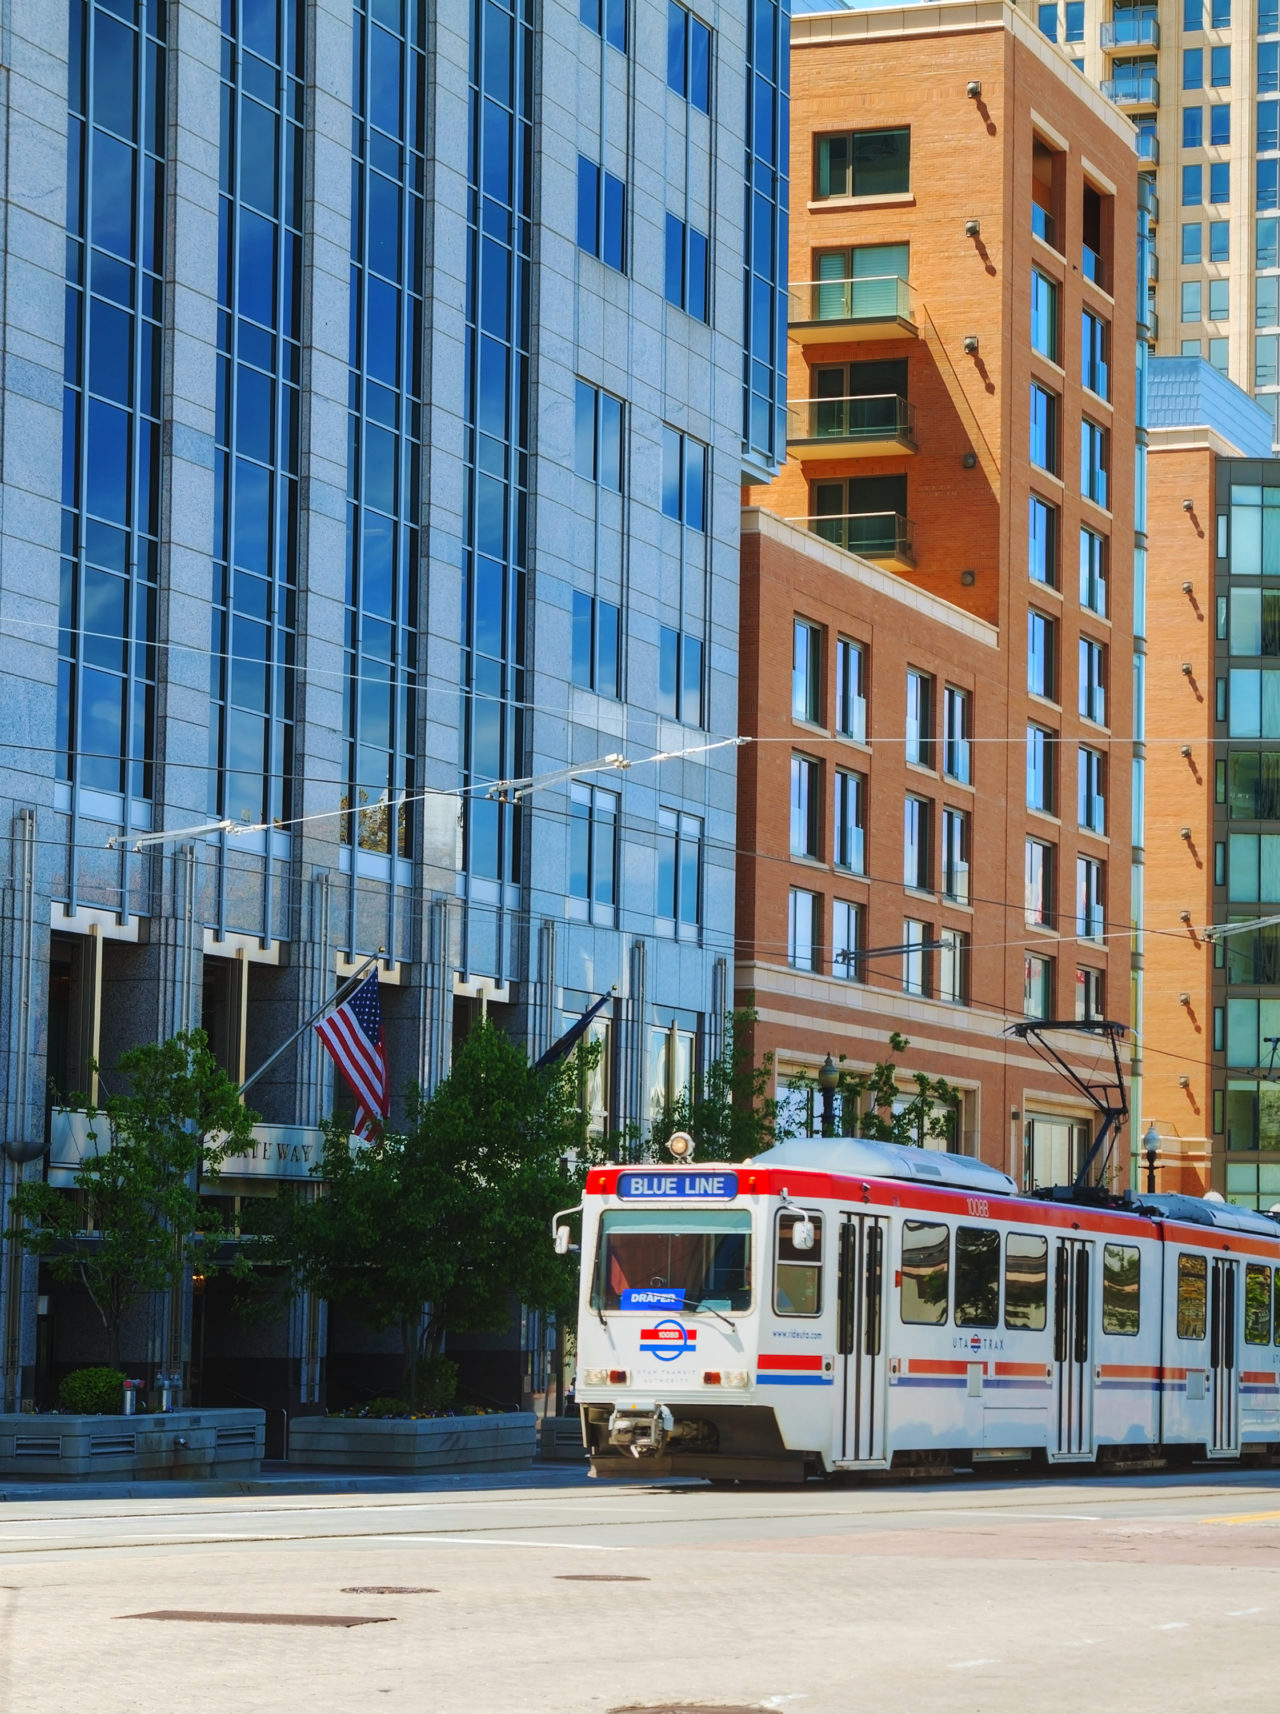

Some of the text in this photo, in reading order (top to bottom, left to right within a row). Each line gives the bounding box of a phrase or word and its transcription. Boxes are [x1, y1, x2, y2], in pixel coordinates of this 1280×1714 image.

[630, 1177, 725, 1194] BLUE LINE
[631, 1293, 677, 1303] DRAPER
[952, 1337, 1005, 1351] UTA TRAX
